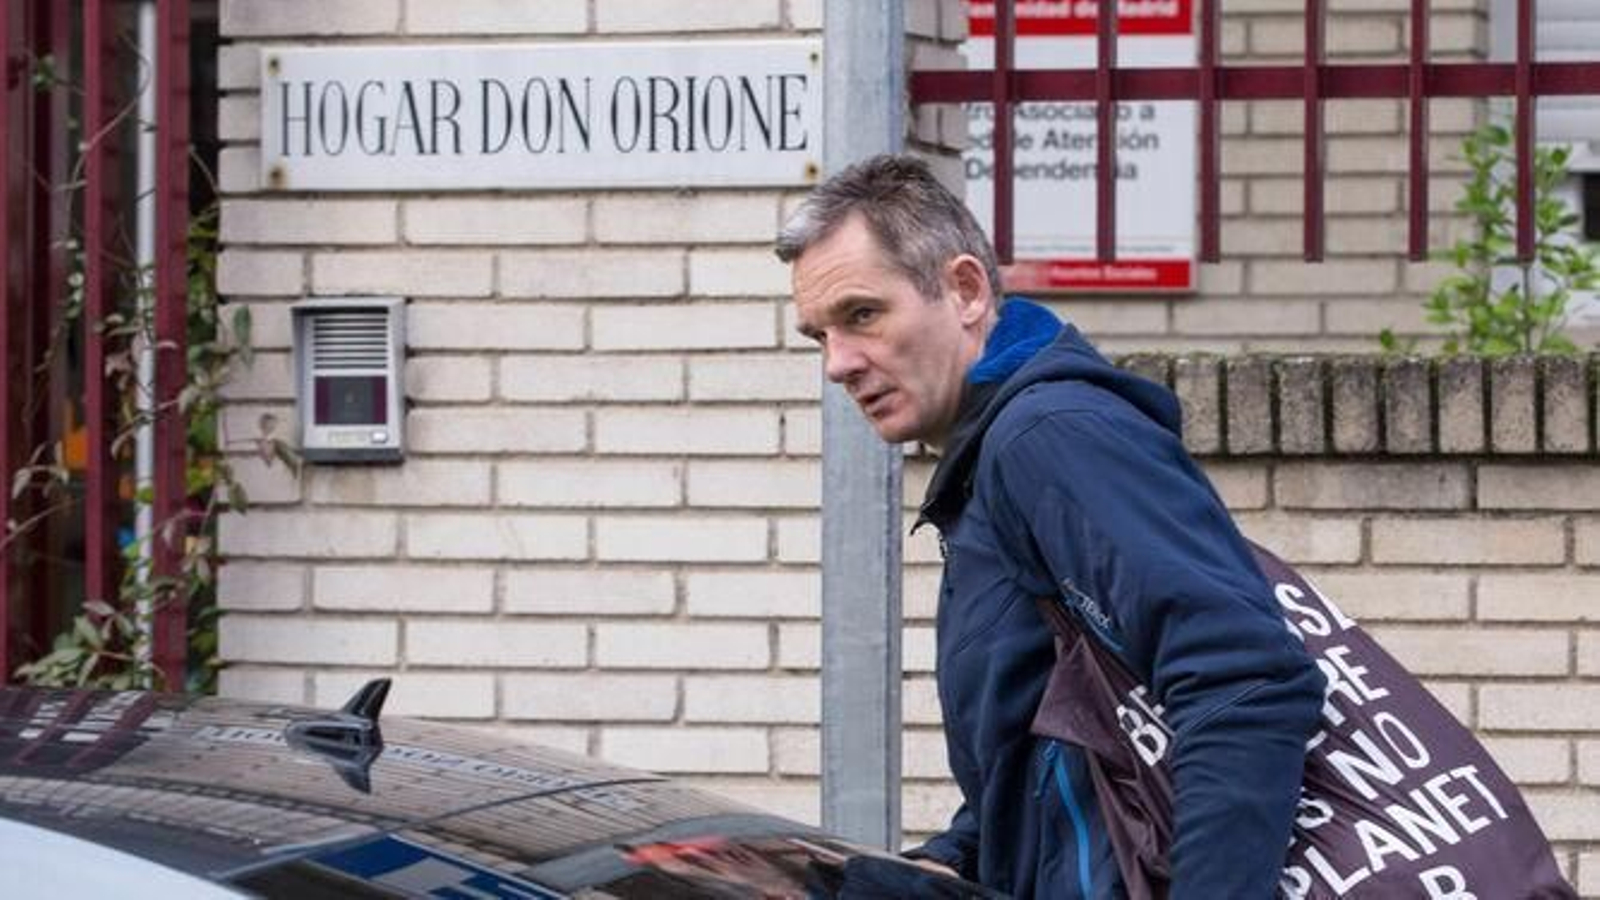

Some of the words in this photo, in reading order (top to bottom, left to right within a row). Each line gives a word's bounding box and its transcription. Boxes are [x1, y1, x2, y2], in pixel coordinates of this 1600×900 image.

[279, 79, 463, 156] HOGAR
[479, 77, 593, 154] DON
[610, 73, 809, 153] ORIONE
[1139, 104, 1156, 119] a
[1042, 129, 1160, 150] Atenión
[964, 157, 1138, 181] Deendenia
[1325, 711, 1431, 801] NO
[1279, 764, 1509, 900] PLANET
